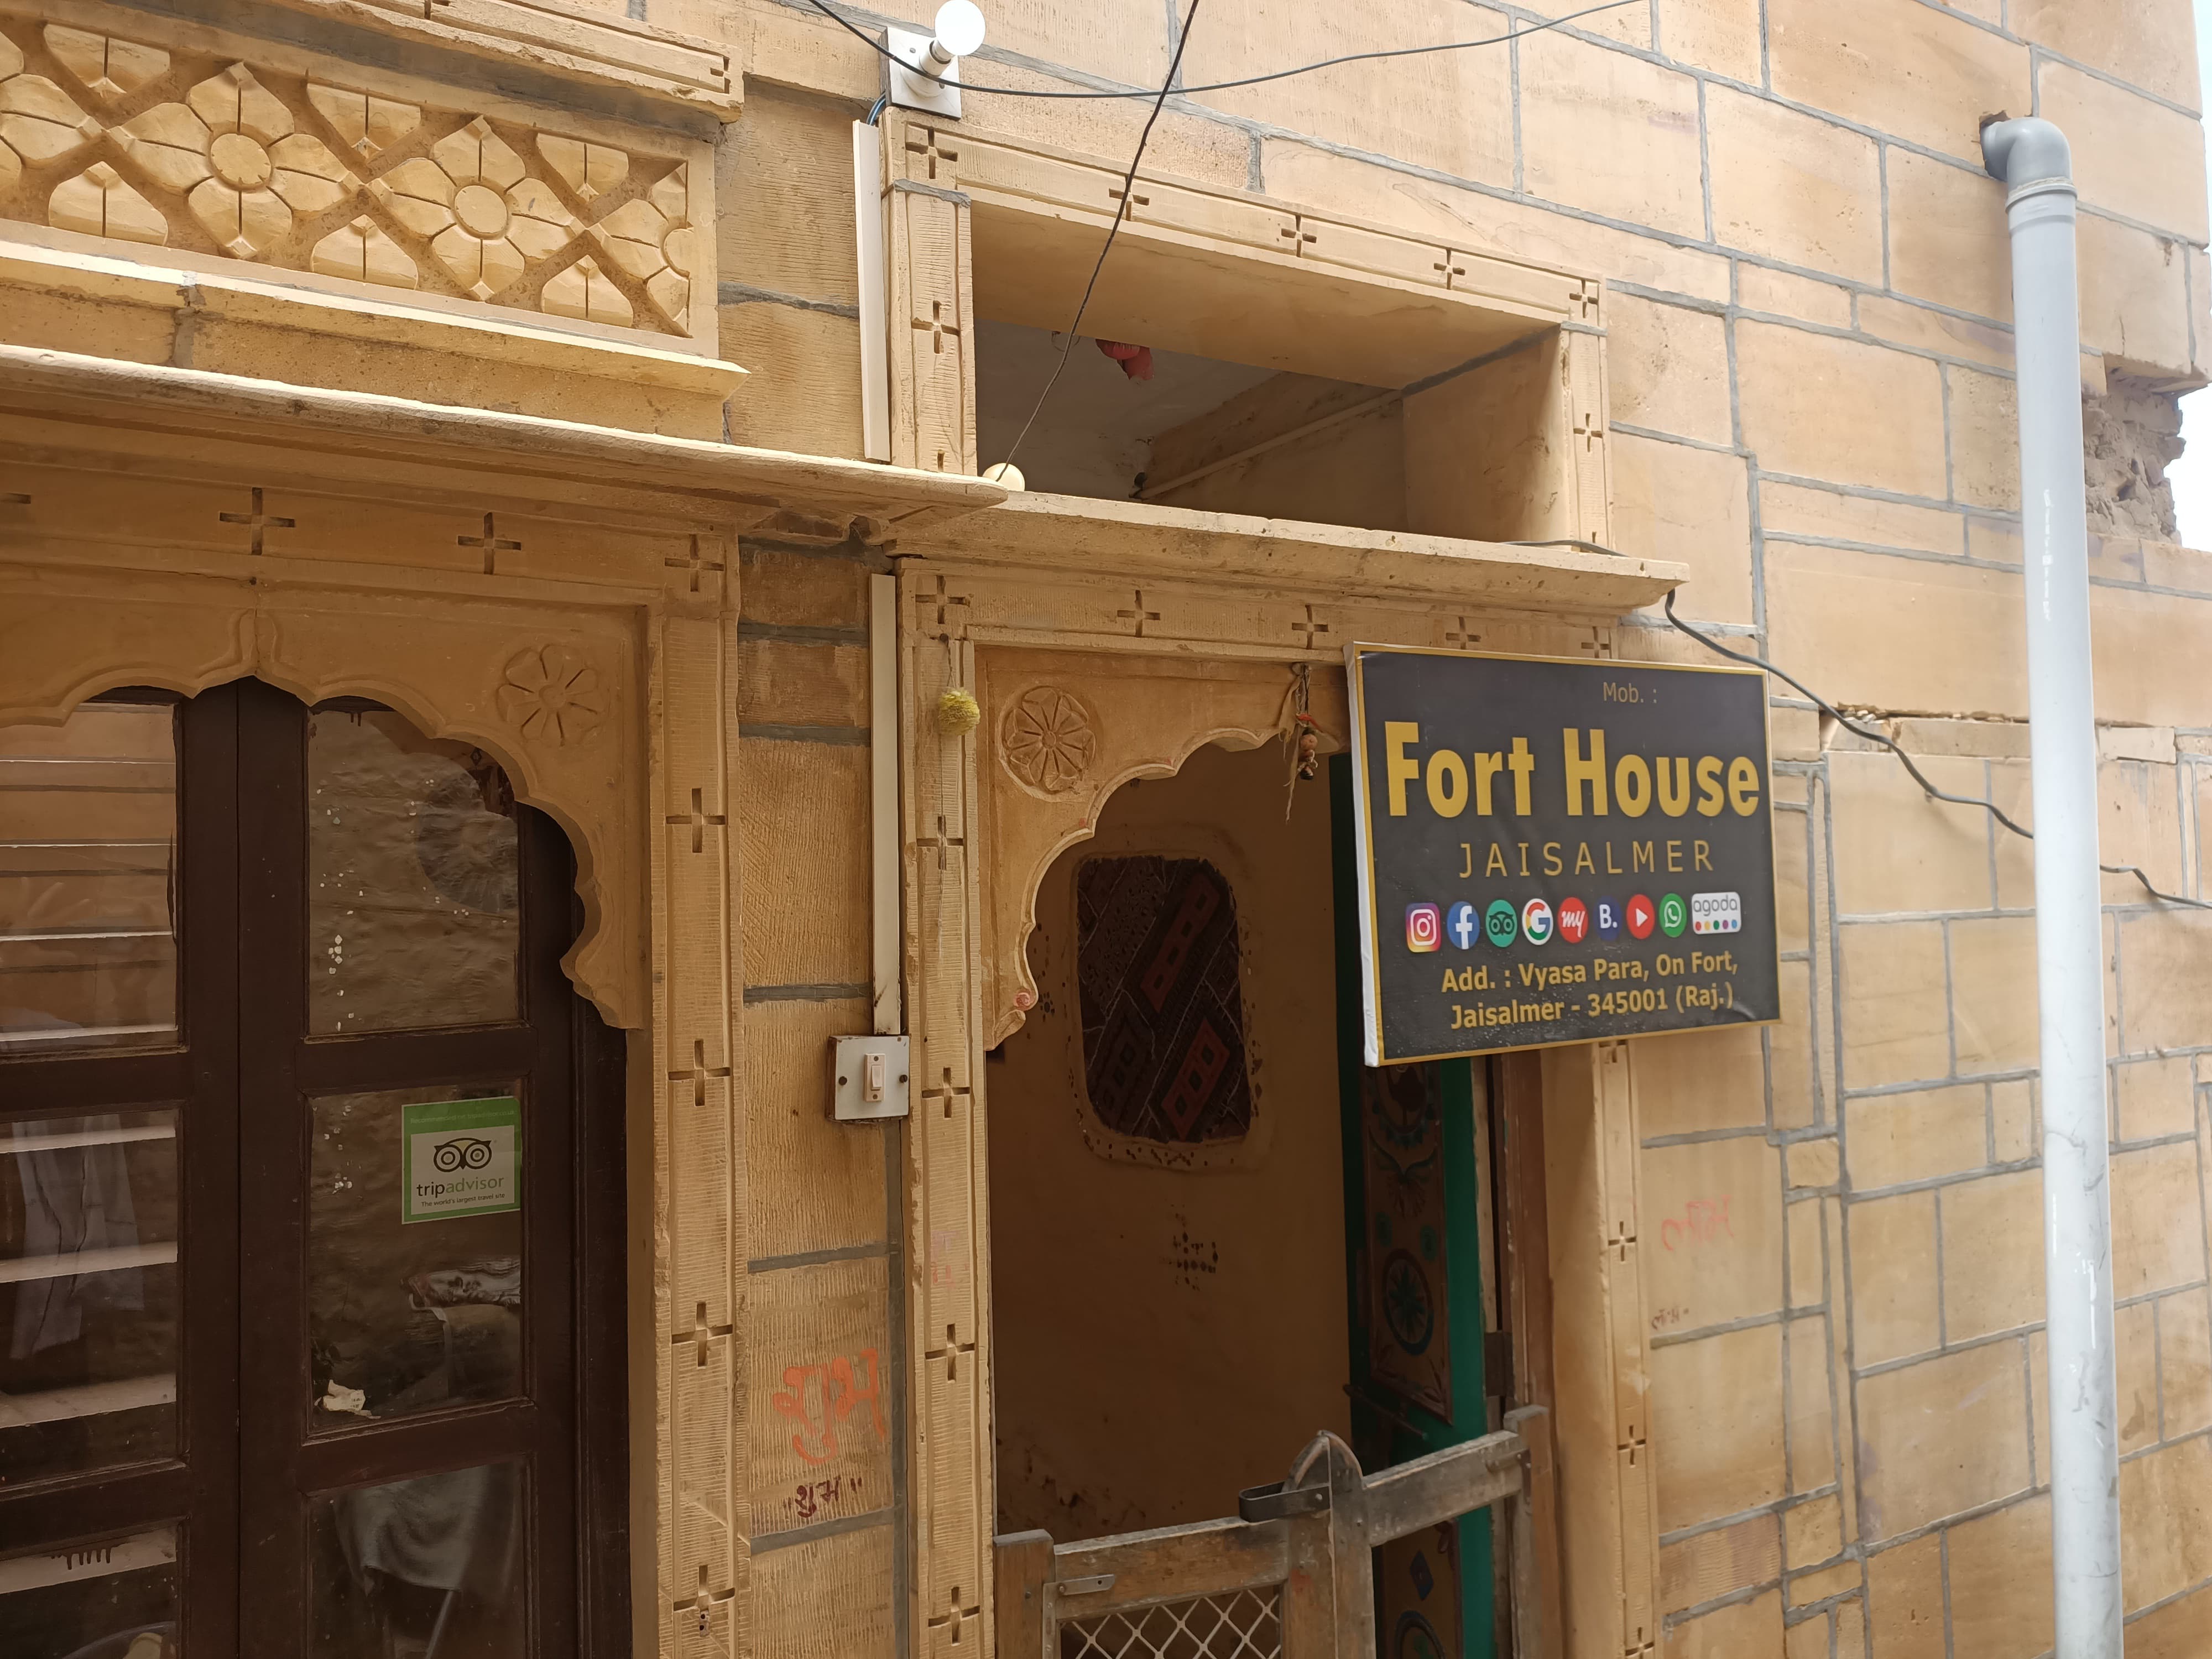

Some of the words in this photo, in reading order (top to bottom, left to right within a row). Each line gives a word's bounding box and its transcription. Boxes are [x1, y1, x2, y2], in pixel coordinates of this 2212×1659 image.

[1603, 682, 1644, 704] Mob.
[1384, 721, 1535, 818] Fort
[1562, 727, 1760, 818] House
[1459, 839, 1714, 879] JAISALMER
[1561, 910, 1584, 937] my
[1693, 894, 1739, 916] agoda
[1441, 965, 1496, 993] Add.
[1517, 963, 1587, 992] Vyasa
[1593, 958, 1649, 982] Para,
[1656, 953, 1685, 977] On
[1691, 950, 1739, 975] Fort,
[1451, 999, 1565, 1030] Jaisalmer
[1587, 989, 1668, 1018] 345001
[1675, 981, 1734, 1014] (Raj.)
[416, 1177, 504, 1198] tripadvisor
[434, 1197, 456, 1206] world's
[456, 1196, 477, 1204] largest
